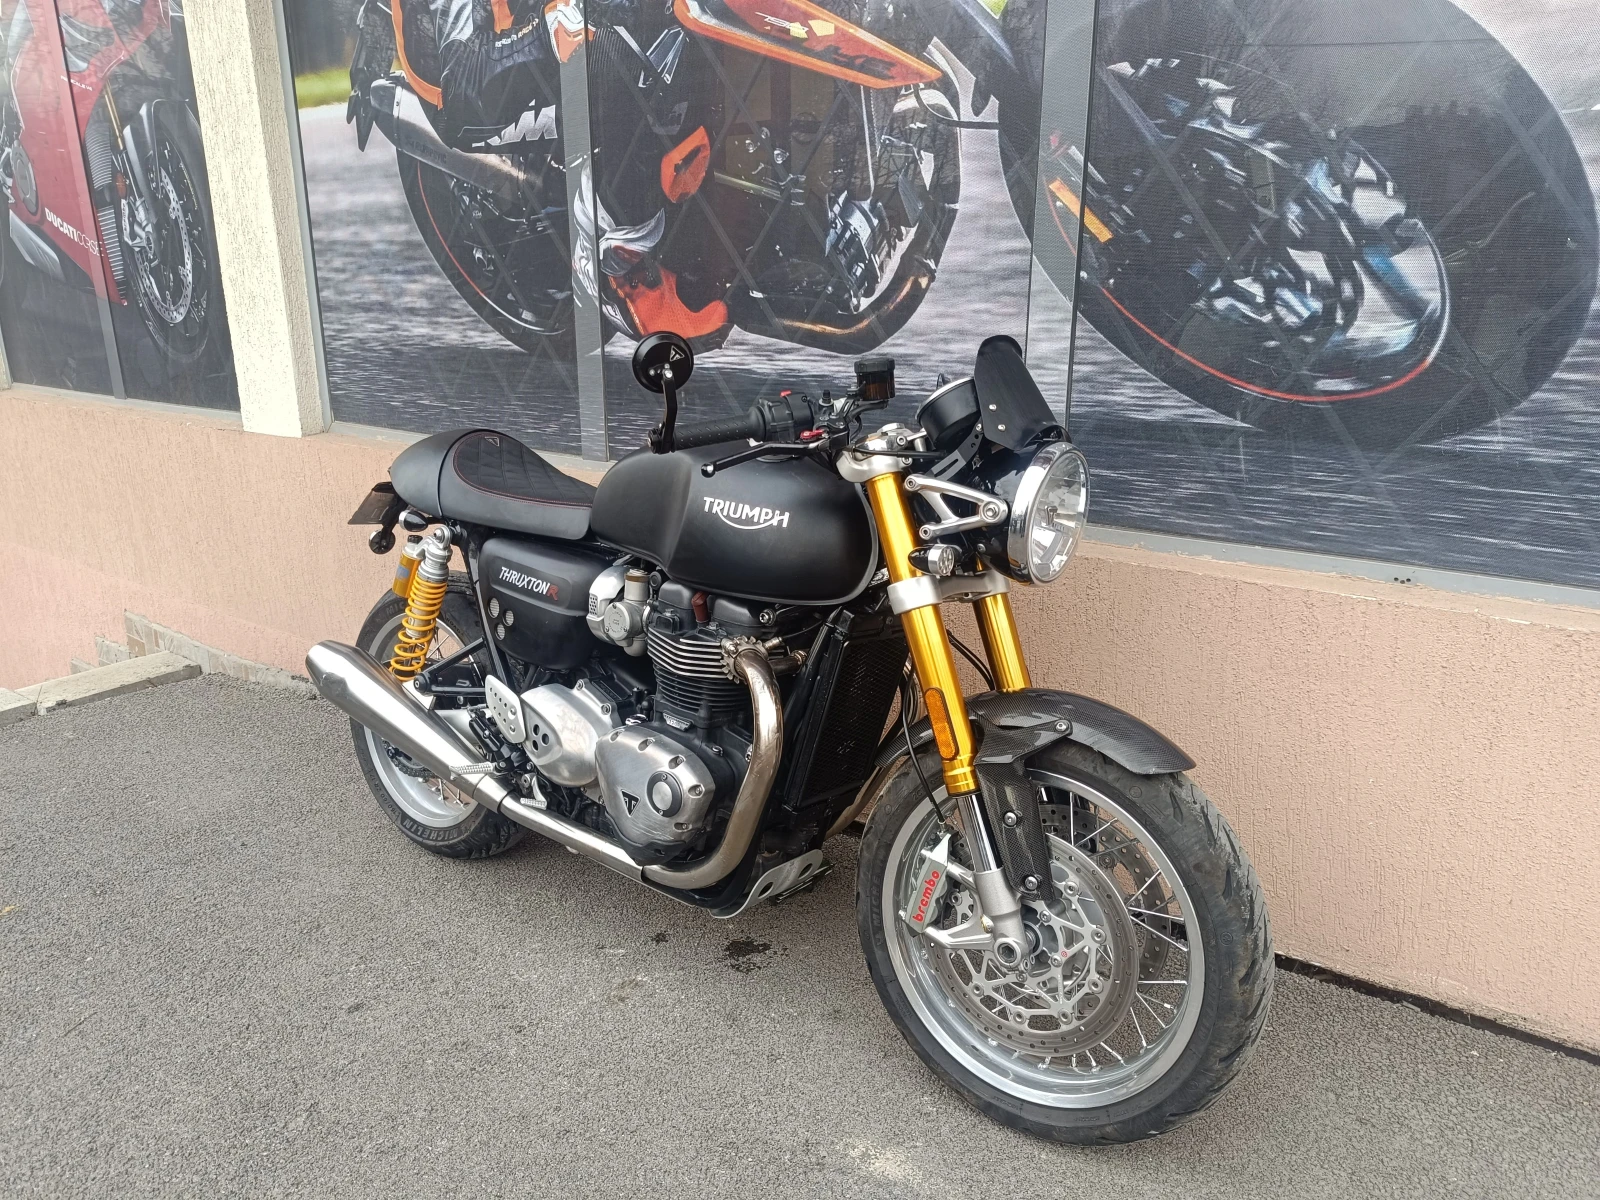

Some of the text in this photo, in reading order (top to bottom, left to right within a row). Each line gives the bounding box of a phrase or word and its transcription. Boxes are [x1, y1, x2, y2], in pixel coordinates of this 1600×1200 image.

[44, 207, 78, 243] DUCATI
[703, 496, 790, 530] TRIUMPH
[499, 566, 560, 601] THRUXTON R
[402, 819, 459, 840] MICHELIN
[912, 870, 940, 922] brembo
